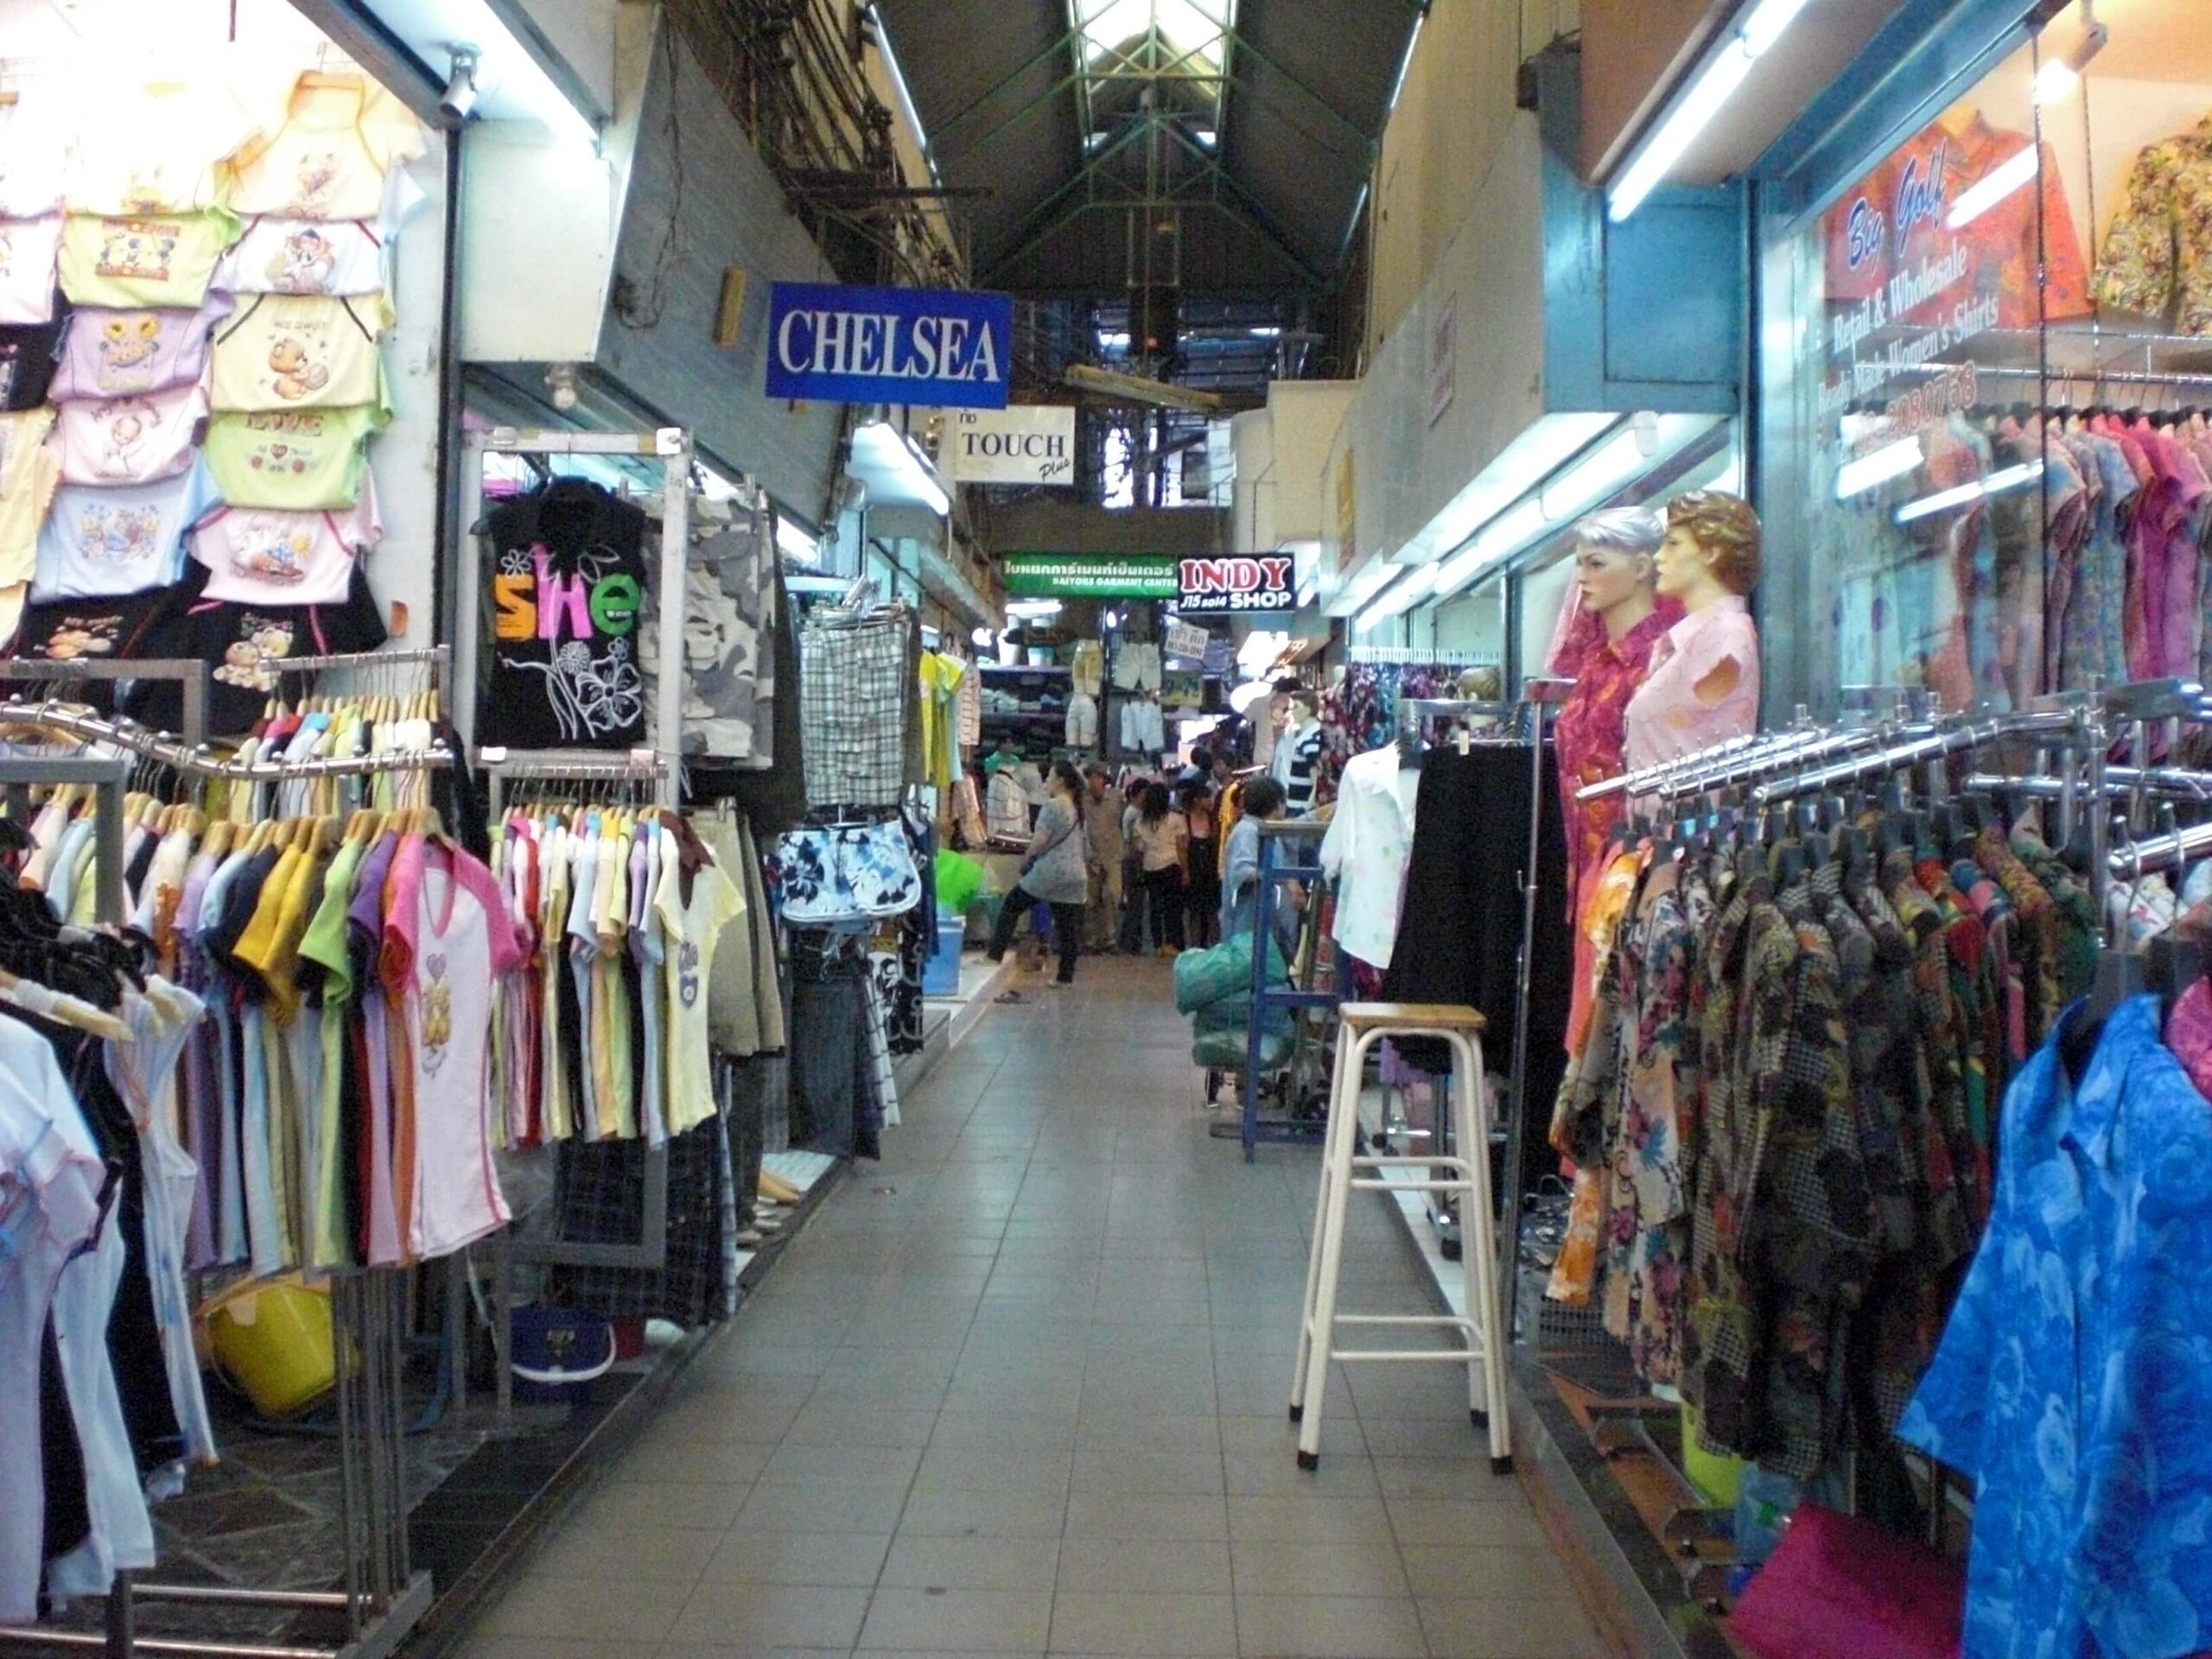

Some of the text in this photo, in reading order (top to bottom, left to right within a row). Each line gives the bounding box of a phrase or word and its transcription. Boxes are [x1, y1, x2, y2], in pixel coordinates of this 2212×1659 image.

[1847, 196, 1885, 277] Big
[1834, 236, 1967, 355] Retail & Wholesale
[778, 309, 1001, 383] CHELSEA
[1888, 311, 1950, 378] Women's
[1954, 292, 1999, 344] Shirts
[961, 432, 1066, 458] TOUCH
[1039, 458, 1071, 482] Plus
[1052, 576, 1179, 588] BAIYOKE GARMENT CENTER
[1179, 557, 1292, 593] INDY
[1230, 591, 1293, 609] SHOP
